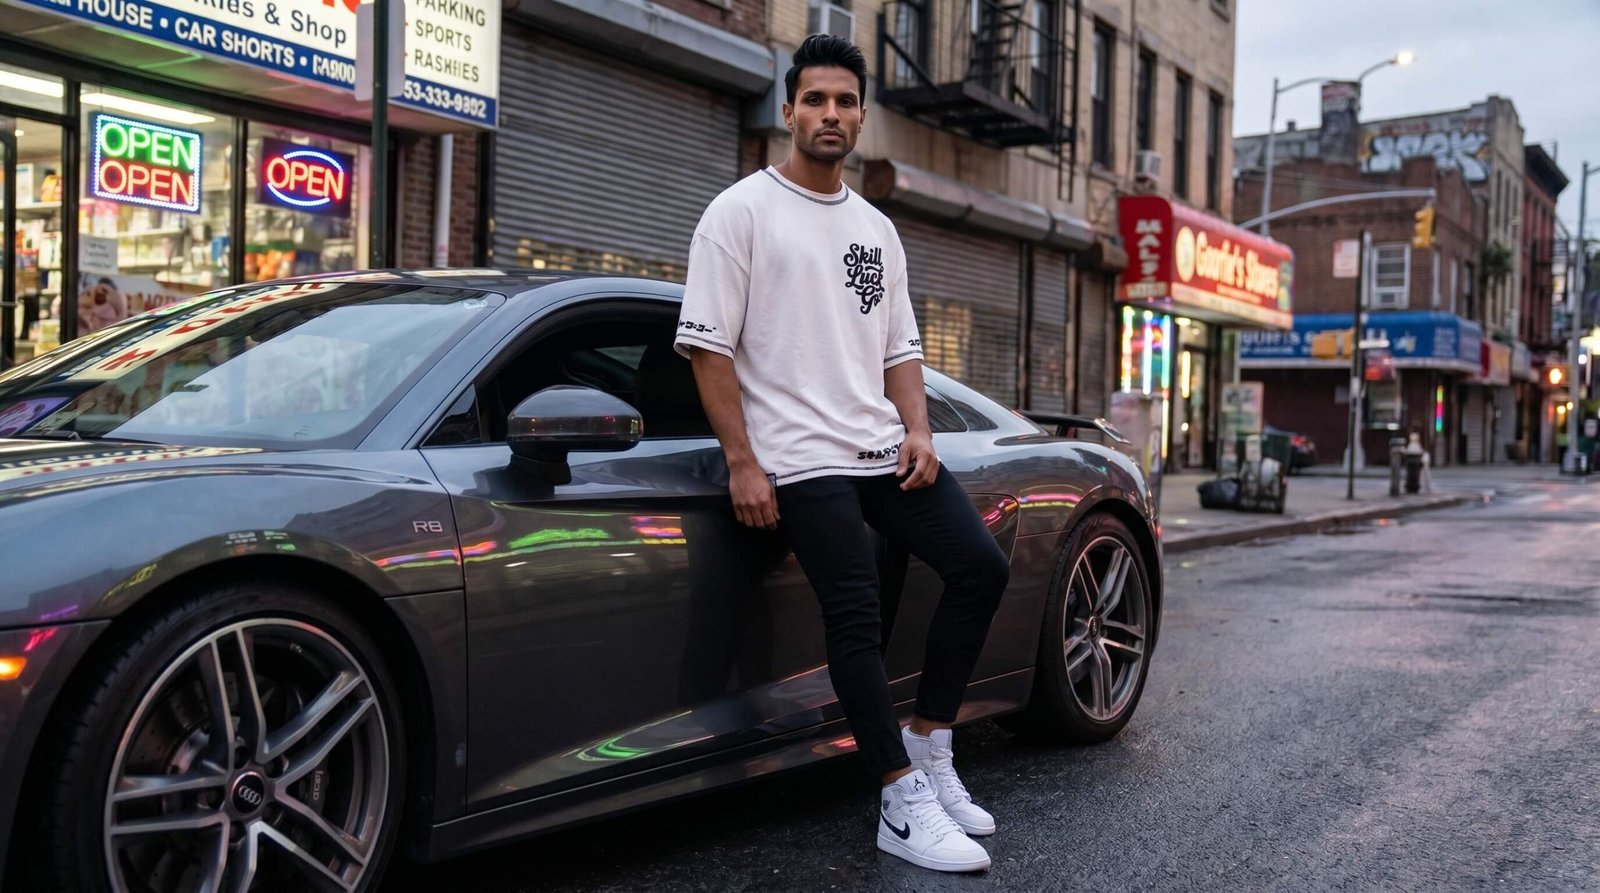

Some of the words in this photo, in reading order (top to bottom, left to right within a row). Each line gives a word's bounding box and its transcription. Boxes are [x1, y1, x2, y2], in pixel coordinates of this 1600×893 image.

[174, 17, 217, 48] CAR
[221, 29, 295, 68] SHORTS
[264, 3, 280, 26] &
[291, 10, 346, 48] Shop
[415, 19, 472, 52] SPORTS
[100, 122, 195, 170] OPEN
[100, 160, 194, 206] OPEN
[267, 157, 344, 200] OPEN
[843, 243, 882, 268] Skill
[413, 521, 443, 532] R8
